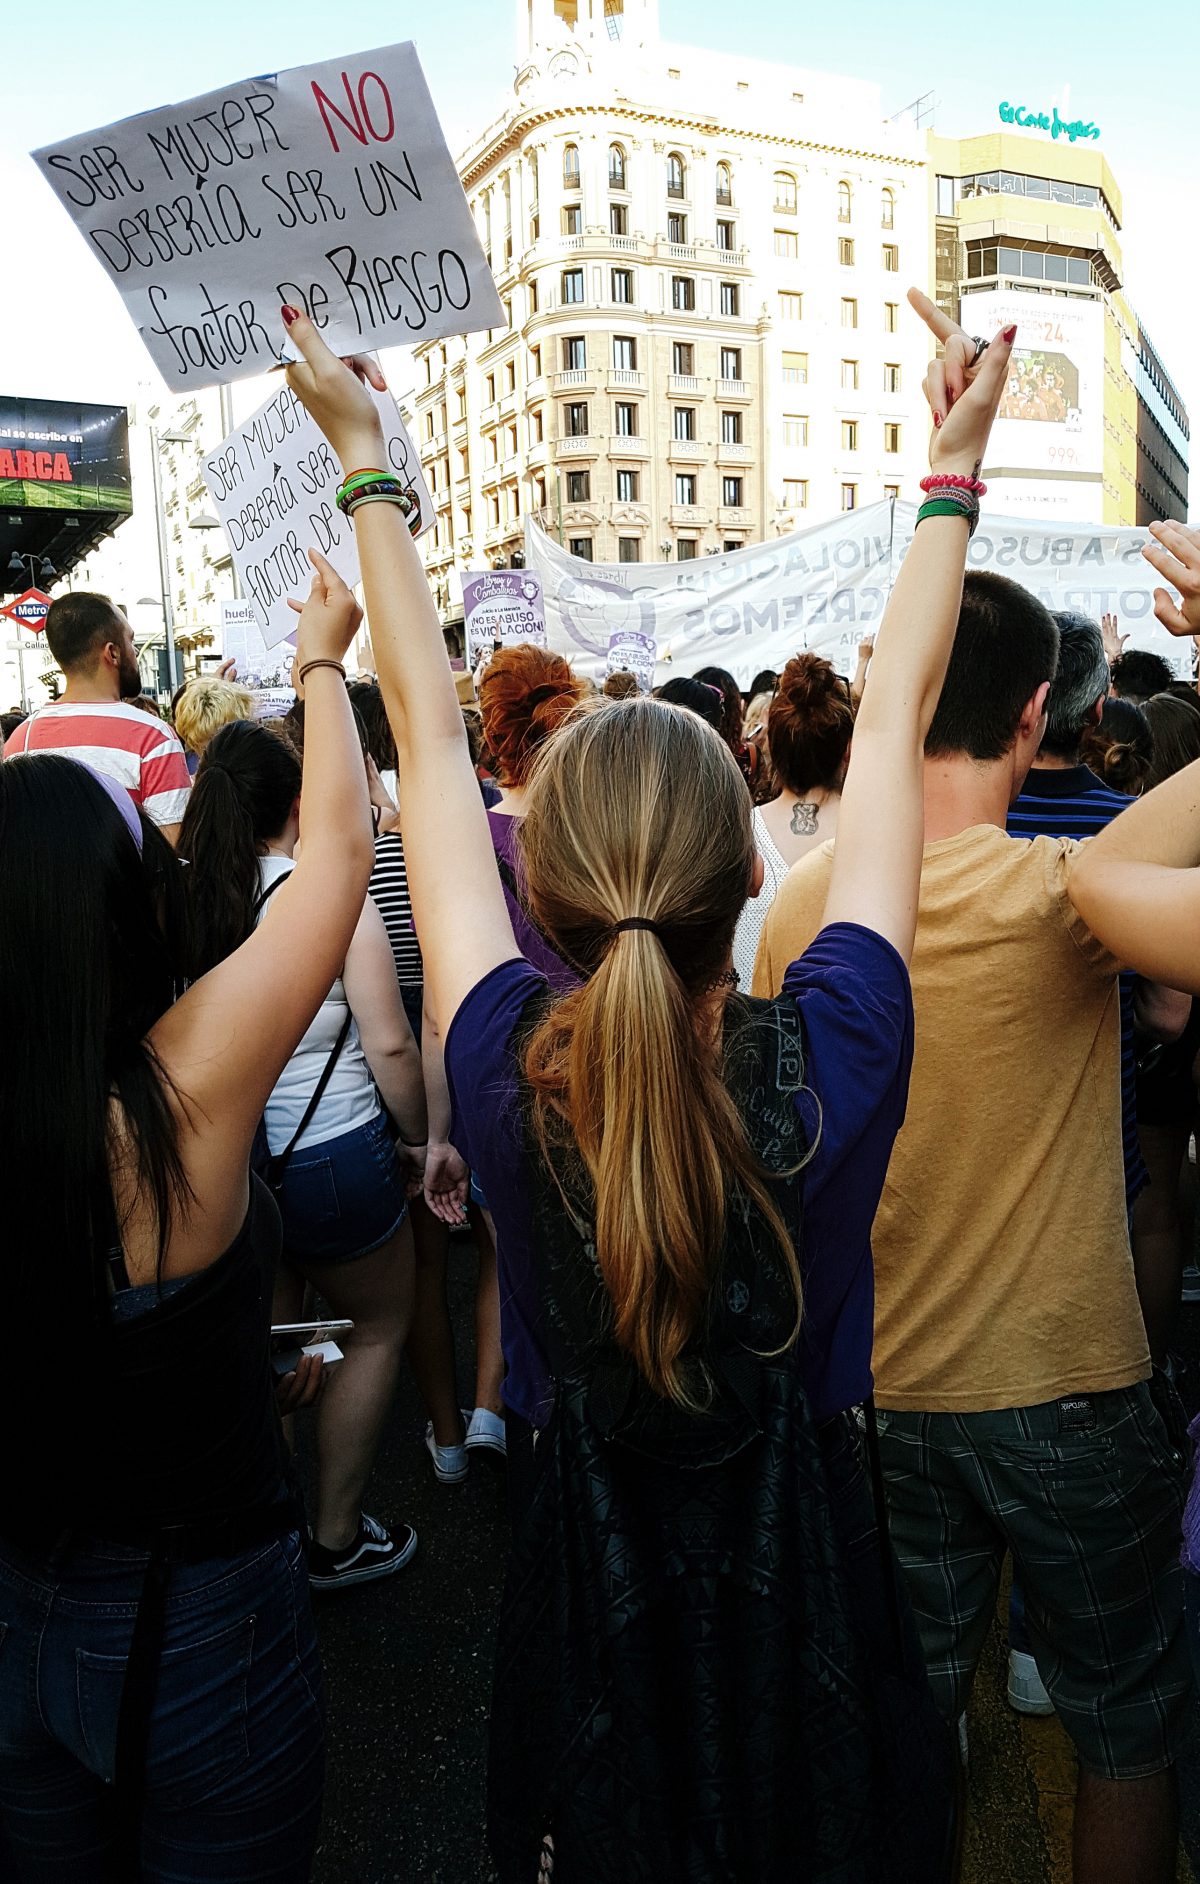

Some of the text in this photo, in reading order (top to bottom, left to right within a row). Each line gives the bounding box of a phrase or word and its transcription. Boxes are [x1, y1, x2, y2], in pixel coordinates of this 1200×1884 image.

[310, 71, 395, 152] NO
[999, 101, 1015, 124] El
[1015, 106, 1050, 130] Corte
[354, 151, 422, 217] UN
[0, 448, 73, 481] ARCA
[18, 605, 46, 615] Metro
[225, 607, 255, 619] huelg
[486, 616, 497, 624] ES
[499, 611, 534, 623] ABUSO
